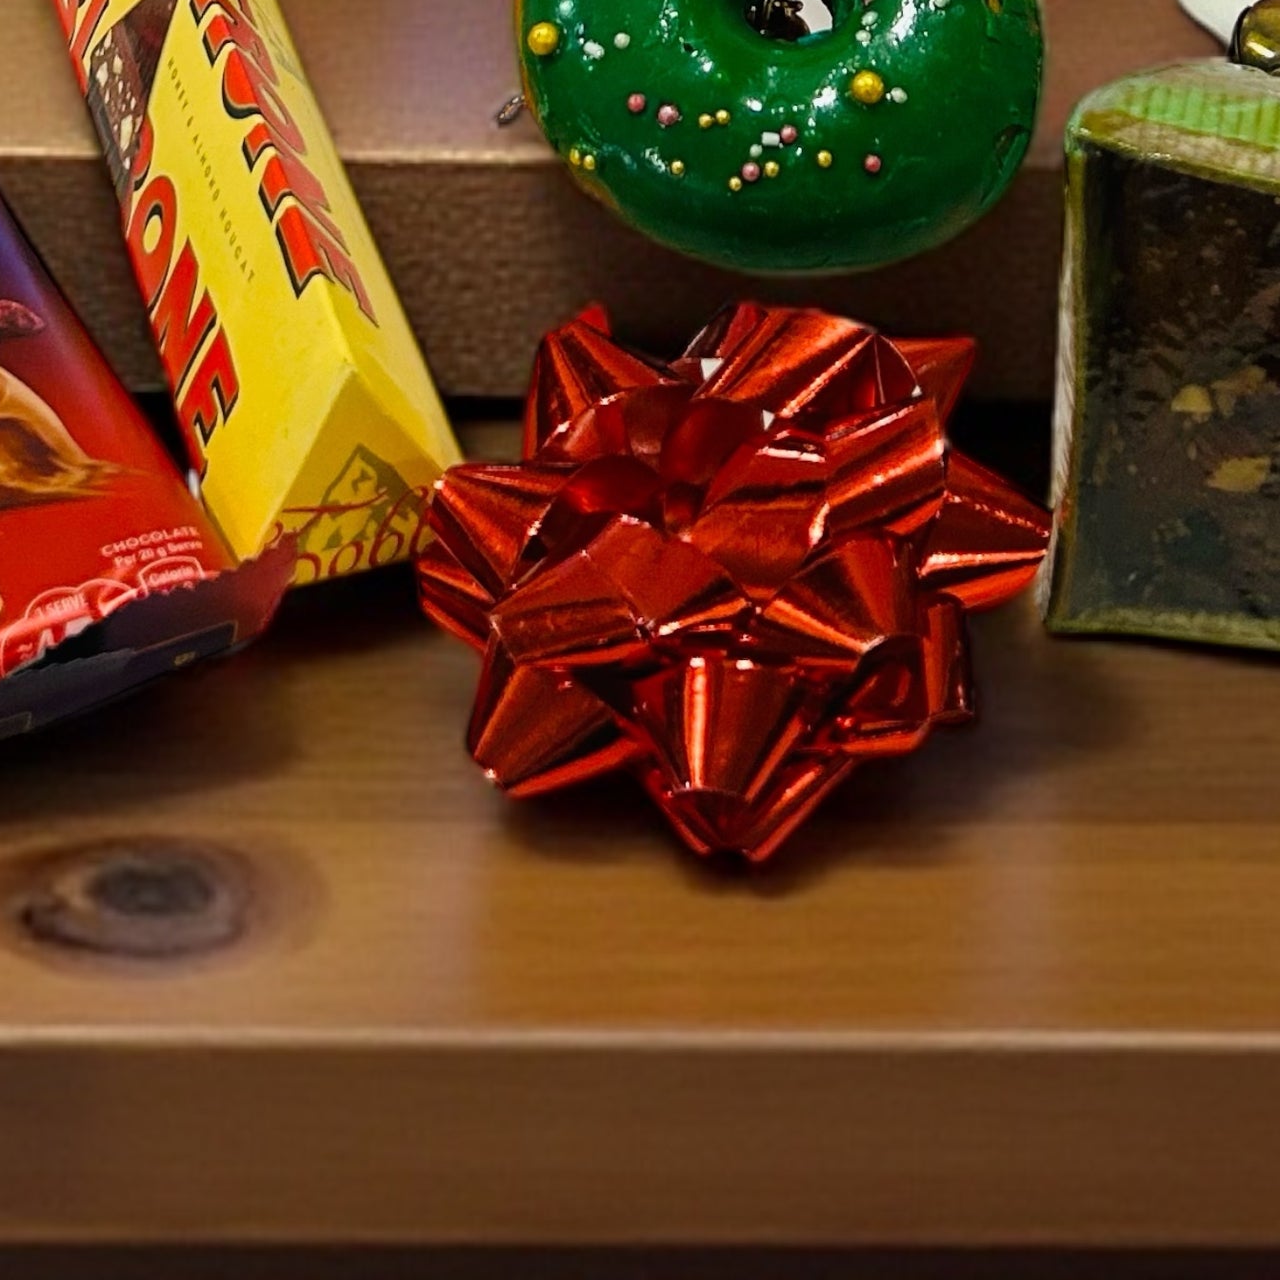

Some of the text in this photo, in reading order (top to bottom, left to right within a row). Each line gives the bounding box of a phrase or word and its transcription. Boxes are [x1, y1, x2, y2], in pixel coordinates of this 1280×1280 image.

[167, 56, 188, 111] HONEY
[192, 133, 220, 201] ALMOND
[220, 207, 256, 283] NOUGAT
[100, 526, 200, 558] CHOCOLATE
[167, 540, 203, 555] Serve
[44, 592, 90, 617] SERVE
